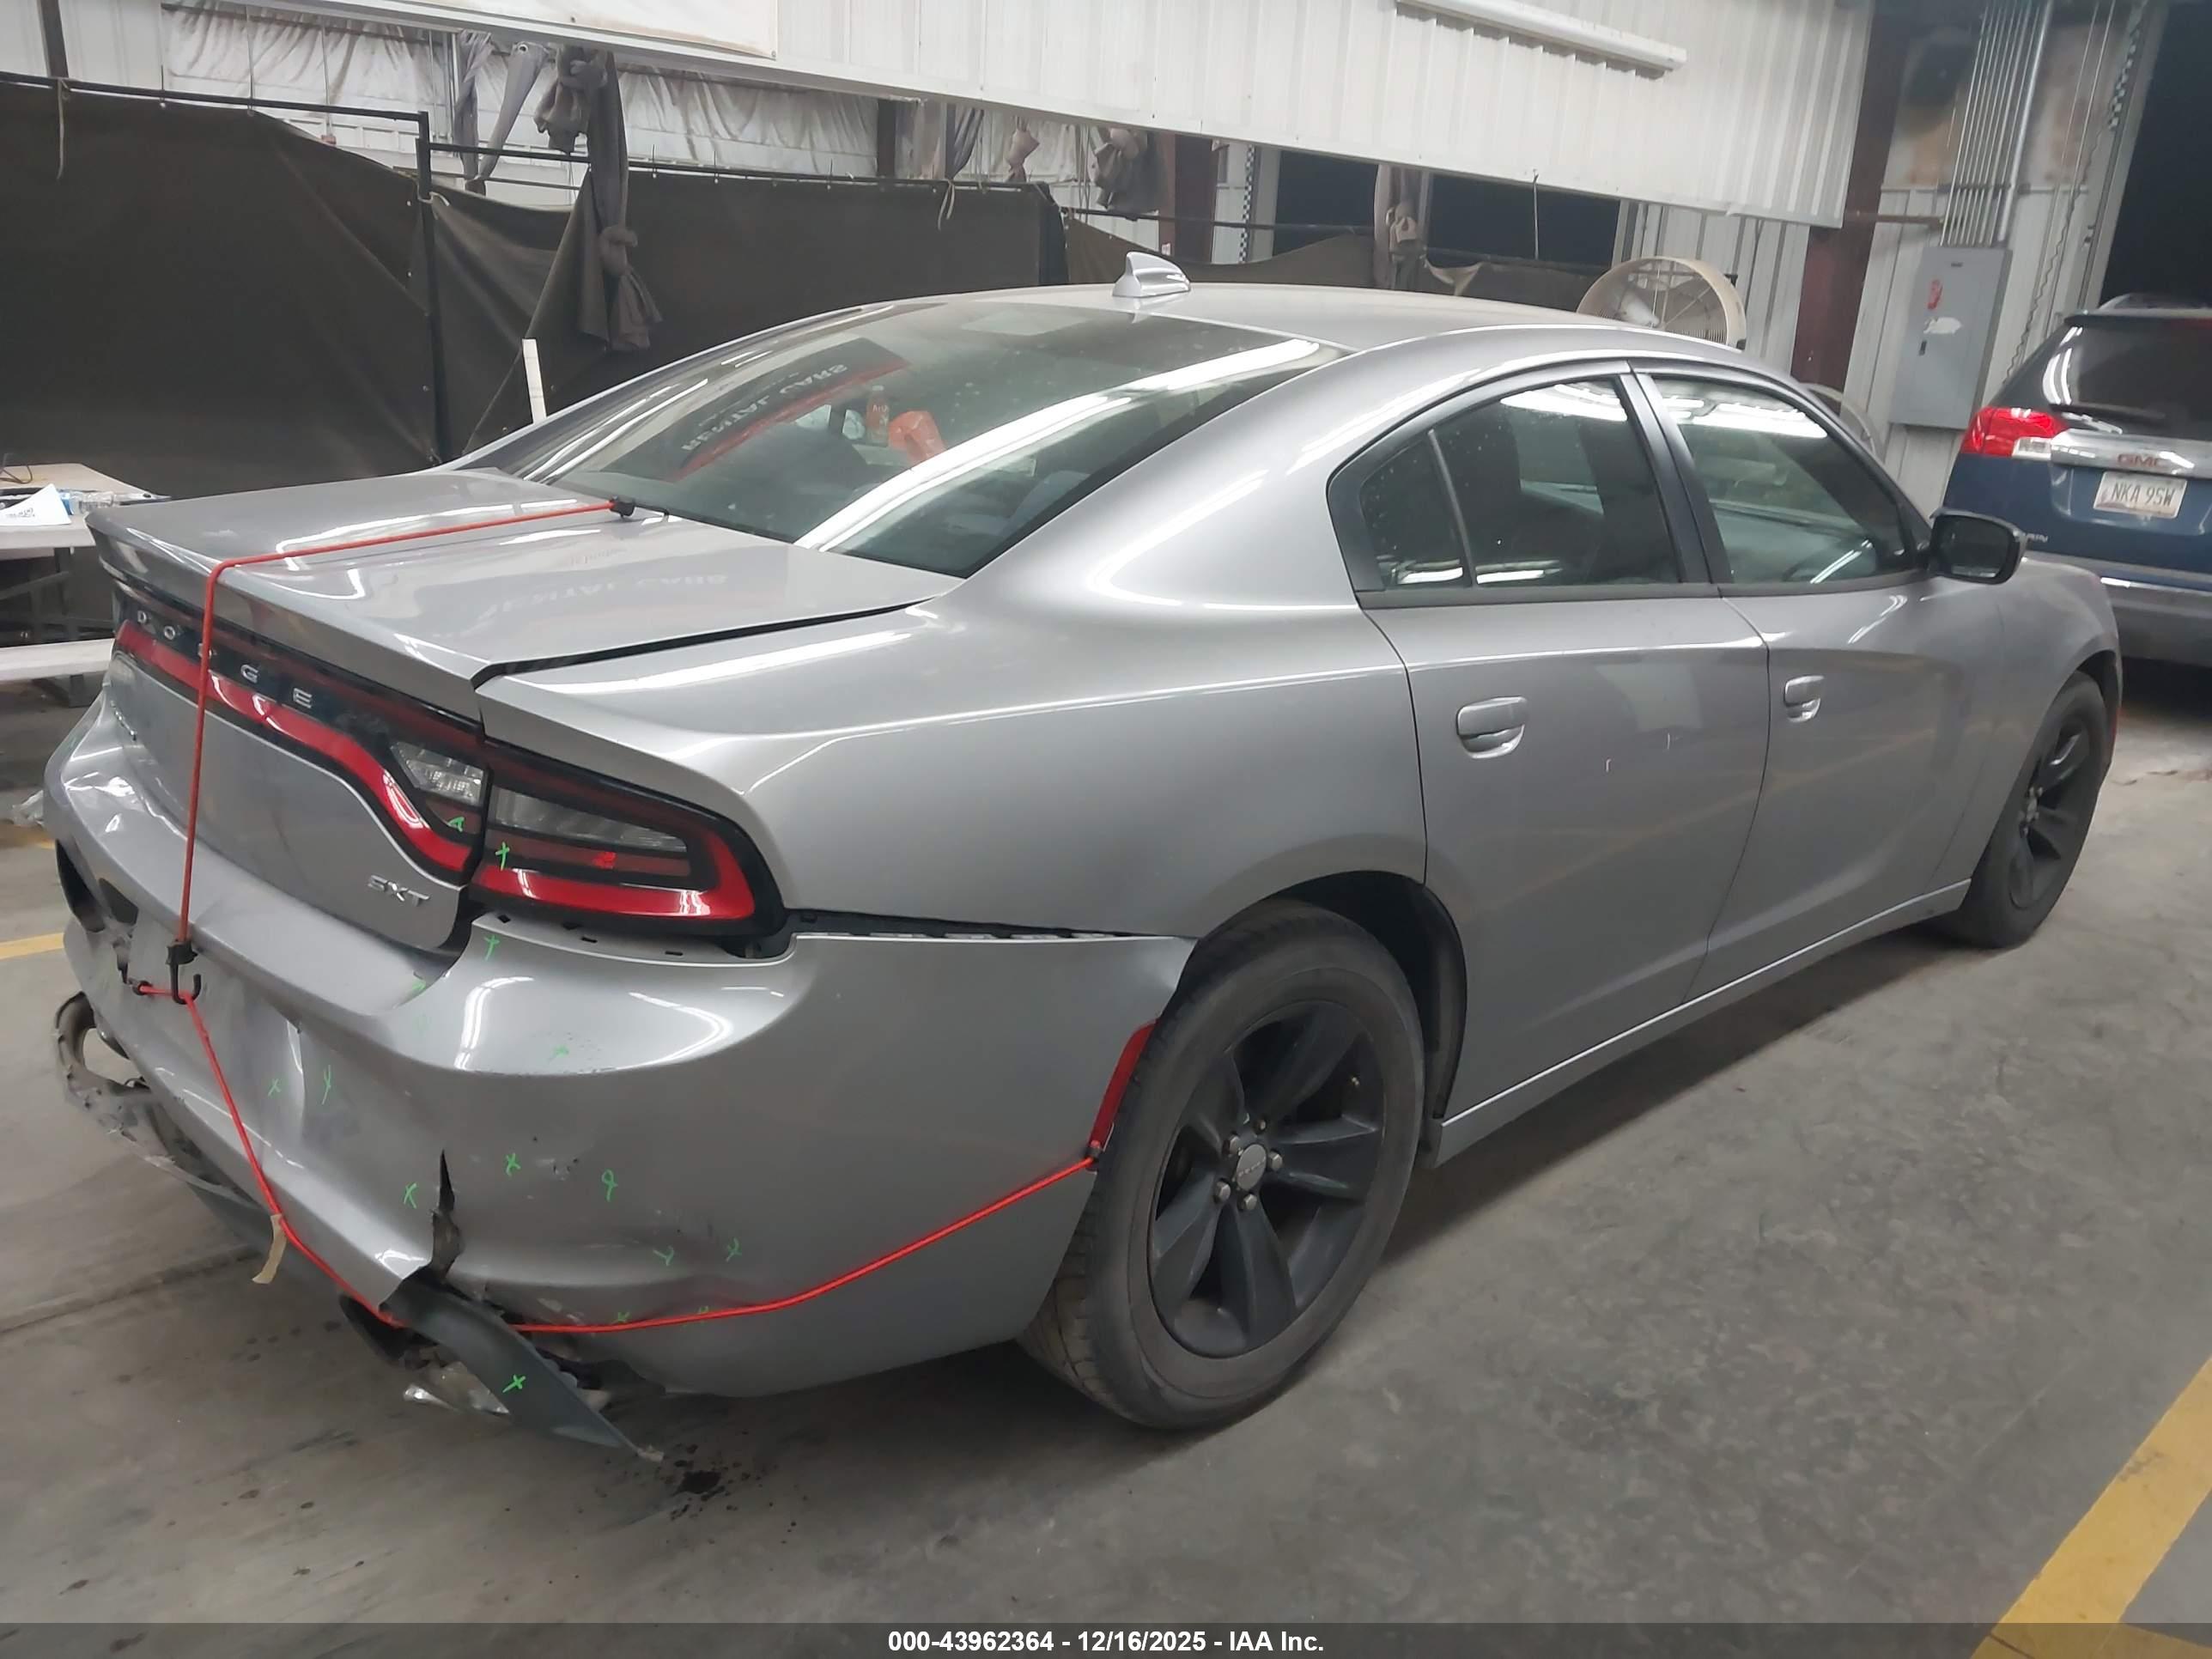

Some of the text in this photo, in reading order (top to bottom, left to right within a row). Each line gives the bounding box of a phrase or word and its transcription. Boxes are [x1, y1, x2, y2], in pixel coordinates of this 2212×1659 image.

[2118, 453, 2169, 469] GMC
[2111, 482, 2142, 503] NKA
[367, 874, 430, 908] SXT
